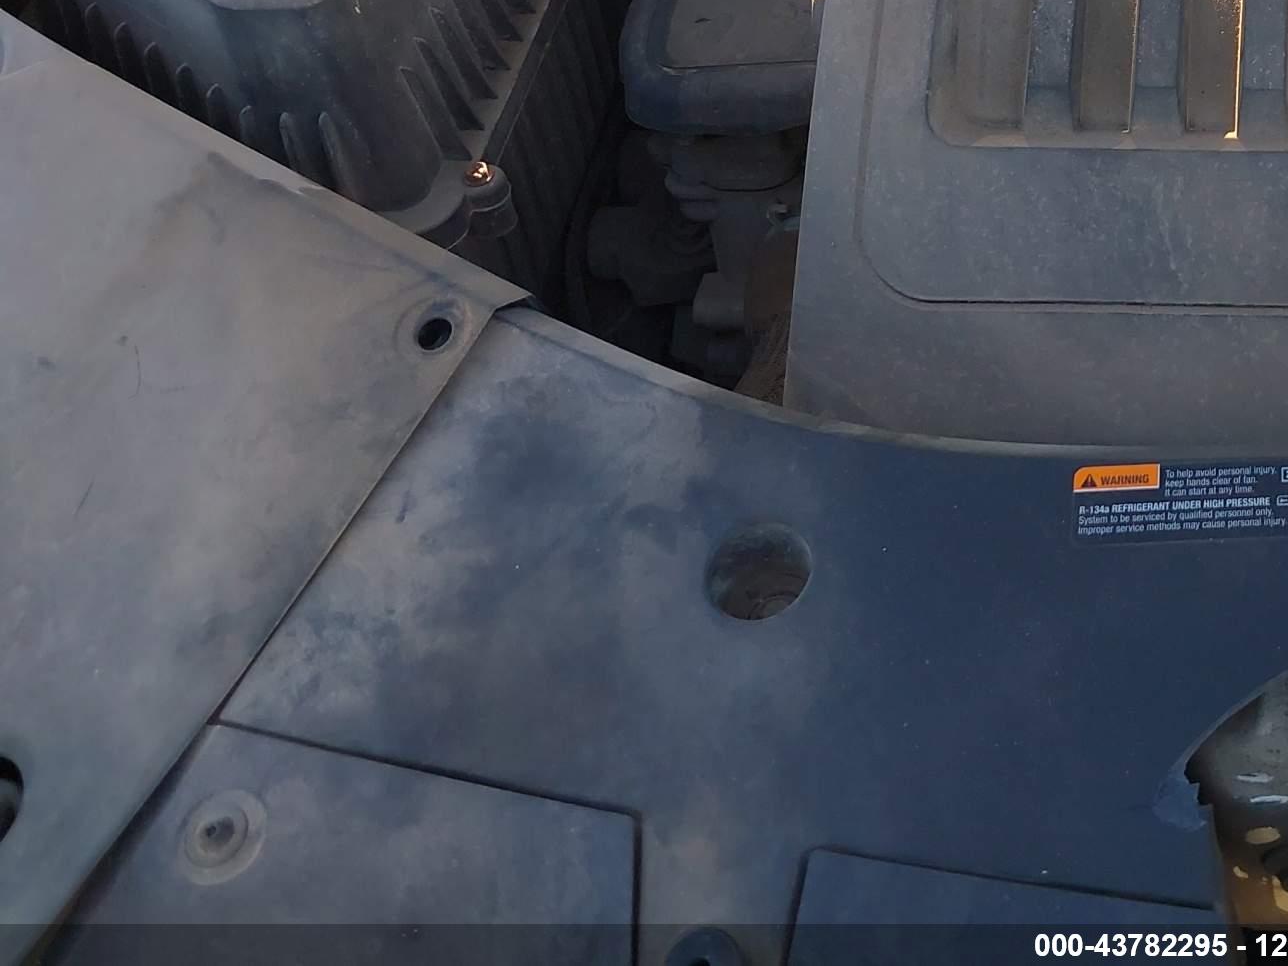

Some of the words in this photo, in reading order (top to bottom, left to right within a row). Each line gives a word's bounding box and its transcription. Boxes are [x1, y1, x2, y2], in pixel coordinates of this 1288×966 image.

[1165, 469, 1175, 477] To
[1177, 469, 1193, 478] help
[1195, 467, 1216, 477] avoid
[1218, 466, 1251, 477] personal
[1100, 474, 1149, 485] WARNING
[1165, 479, 1184, 488] keep
[1186, 477, 1209, 487] hands
[1212, 476, 1231, 485] clear
[1233, 476, 1241, 484] of
[1188, 486, 1206, 495] start
[1208, 486, 1216, 495] at
[1219, 486, 1232, 495] any
[1079, 505, 1109, 514] R-134a
[1112, 501, 1170, 513] REFRIGERANT
[1172, 499, 1201, 510] UNDER
[1203, 497, 1224, 508] HIGH
[1226, 496, 1270, 507] PRESSURE
[1078, 515, 1108, 525] System
[1111, 515, 1118, 523] to
[1120, 514, 1130, 522] be
[1132, 512, 1165, 522] serviced
[1167, 512, 1177, 521] by
[1179, 509, 1213, 520] qualified
[1215, 507, 1253, 518] personnel
[1078, 525, 1114, 536] Improper
[1115, 524, 1145, 533] service
[1146, 522, 1181, 531] methods
[1183, 521, 1200, 530] may
[1202, 520, 1225, 529] cause
[1227, 518, 1261, 529] personal
